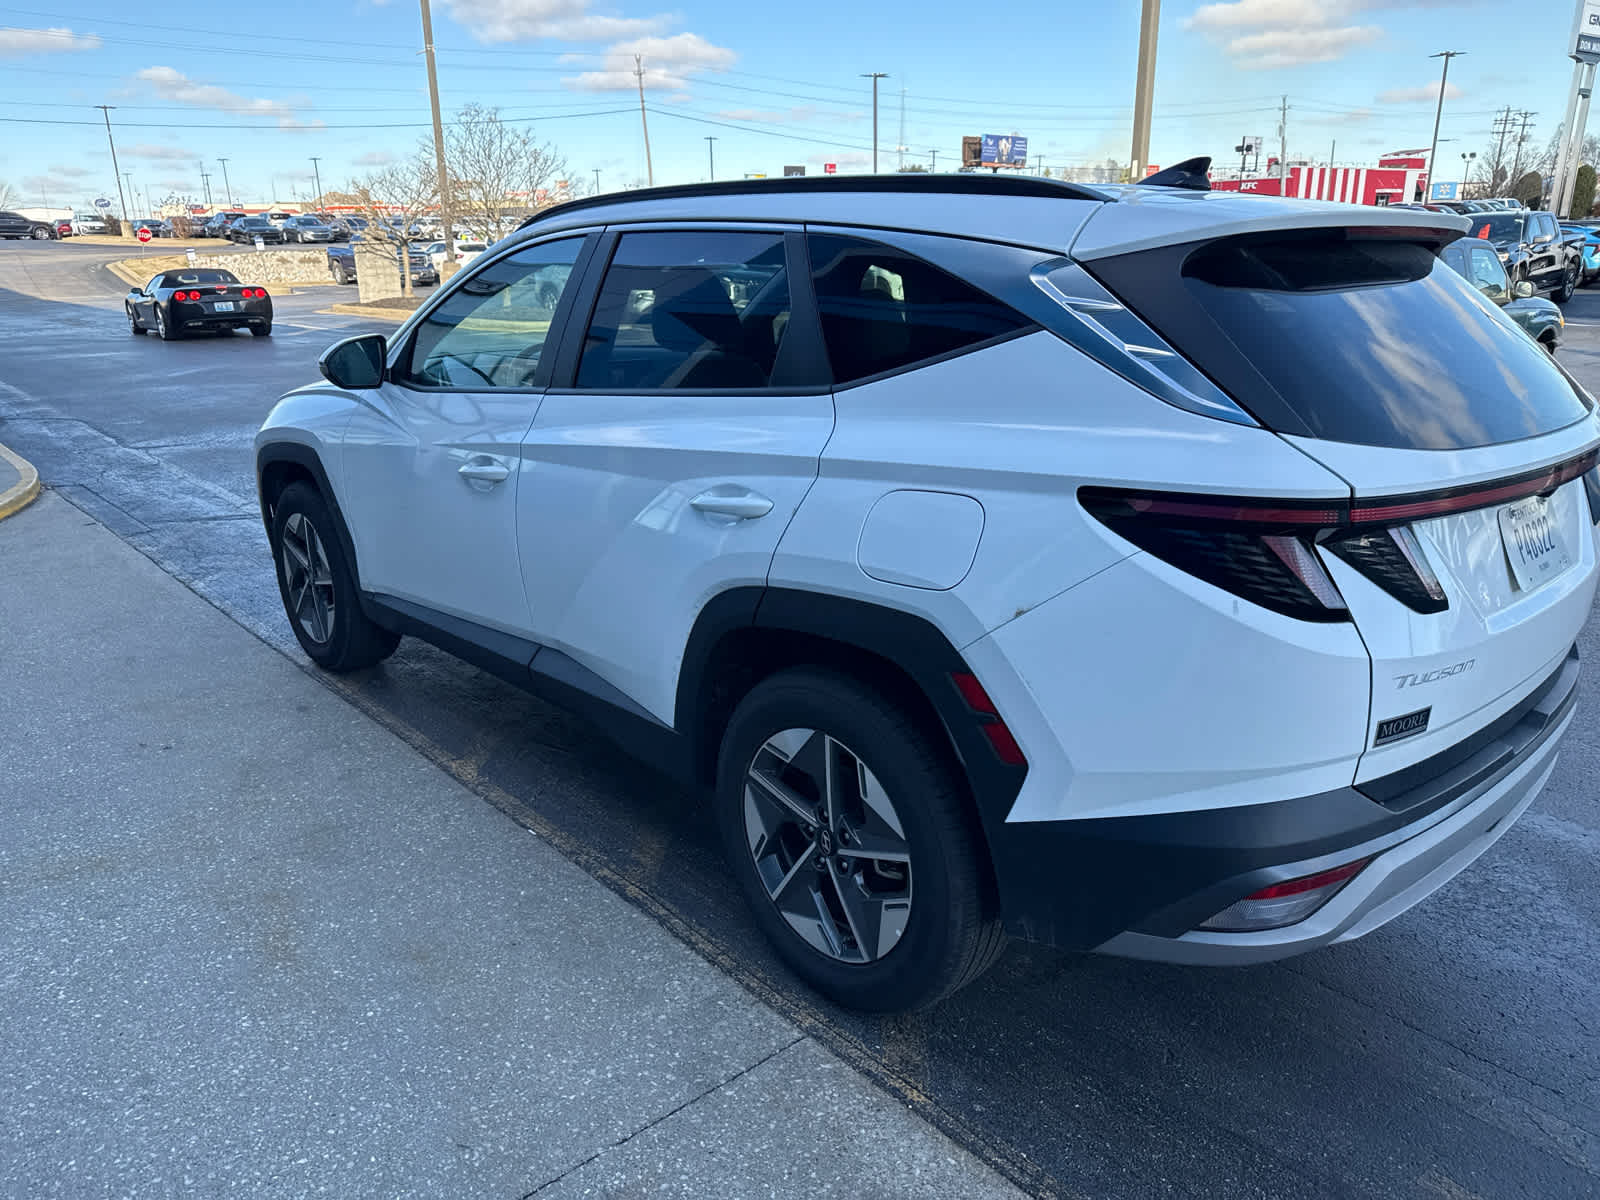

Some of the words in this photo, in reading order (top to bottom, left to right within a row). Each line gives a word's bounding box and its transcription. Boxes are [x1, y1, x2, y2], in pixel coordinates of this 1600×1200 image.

[1240, 181, 1258, 190] KFC
[138, 231, 152, 239] STOP
[1381, 711, 1426, 737] MOORE
